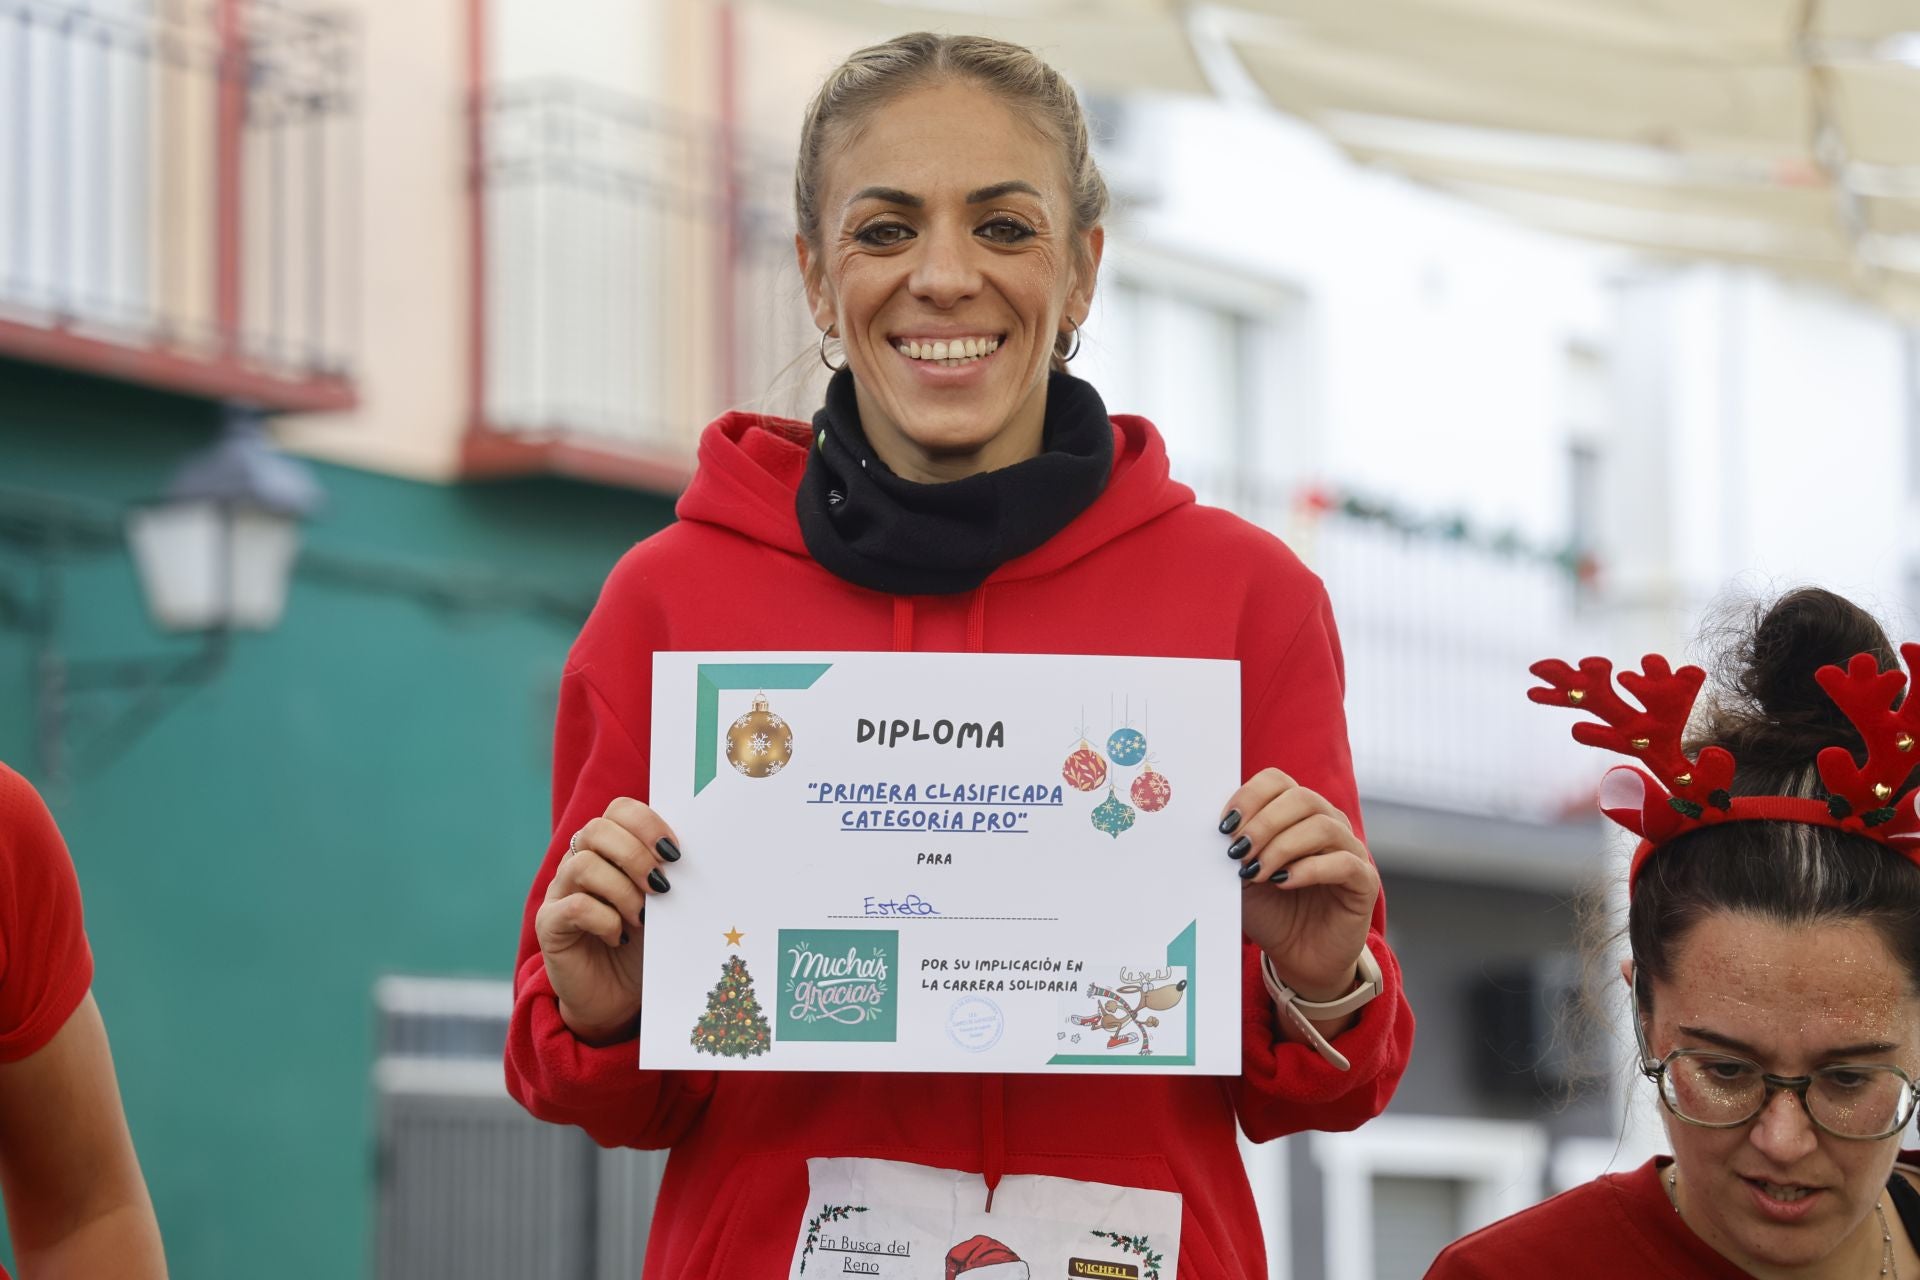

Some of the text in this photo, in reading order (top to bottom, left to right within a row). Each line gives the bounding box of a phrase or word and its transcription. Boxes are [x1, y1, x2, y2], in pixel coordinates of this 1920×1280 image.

[856, 718, 1004, 749] DIPLOMA
[925, 783, 1063, 803] CLASIFICADA
[841, 809, 964, 829] CATEGORÍA
[916, 852, 952, 865] PARA
[864, 894, 941, 915] Estela
[787, 946, 888, 981] Muchas
[921, 956, 1083, 973] POR SU IMPLICACIÓN EN
[921, 978, 1078, 993] LA CARRERA SOLIDARIA
[789, 980, 884, 1025] gracias
[820, 1234, 911, 1255] En Busca del
[843, 1256, 880, 1273] Reno
